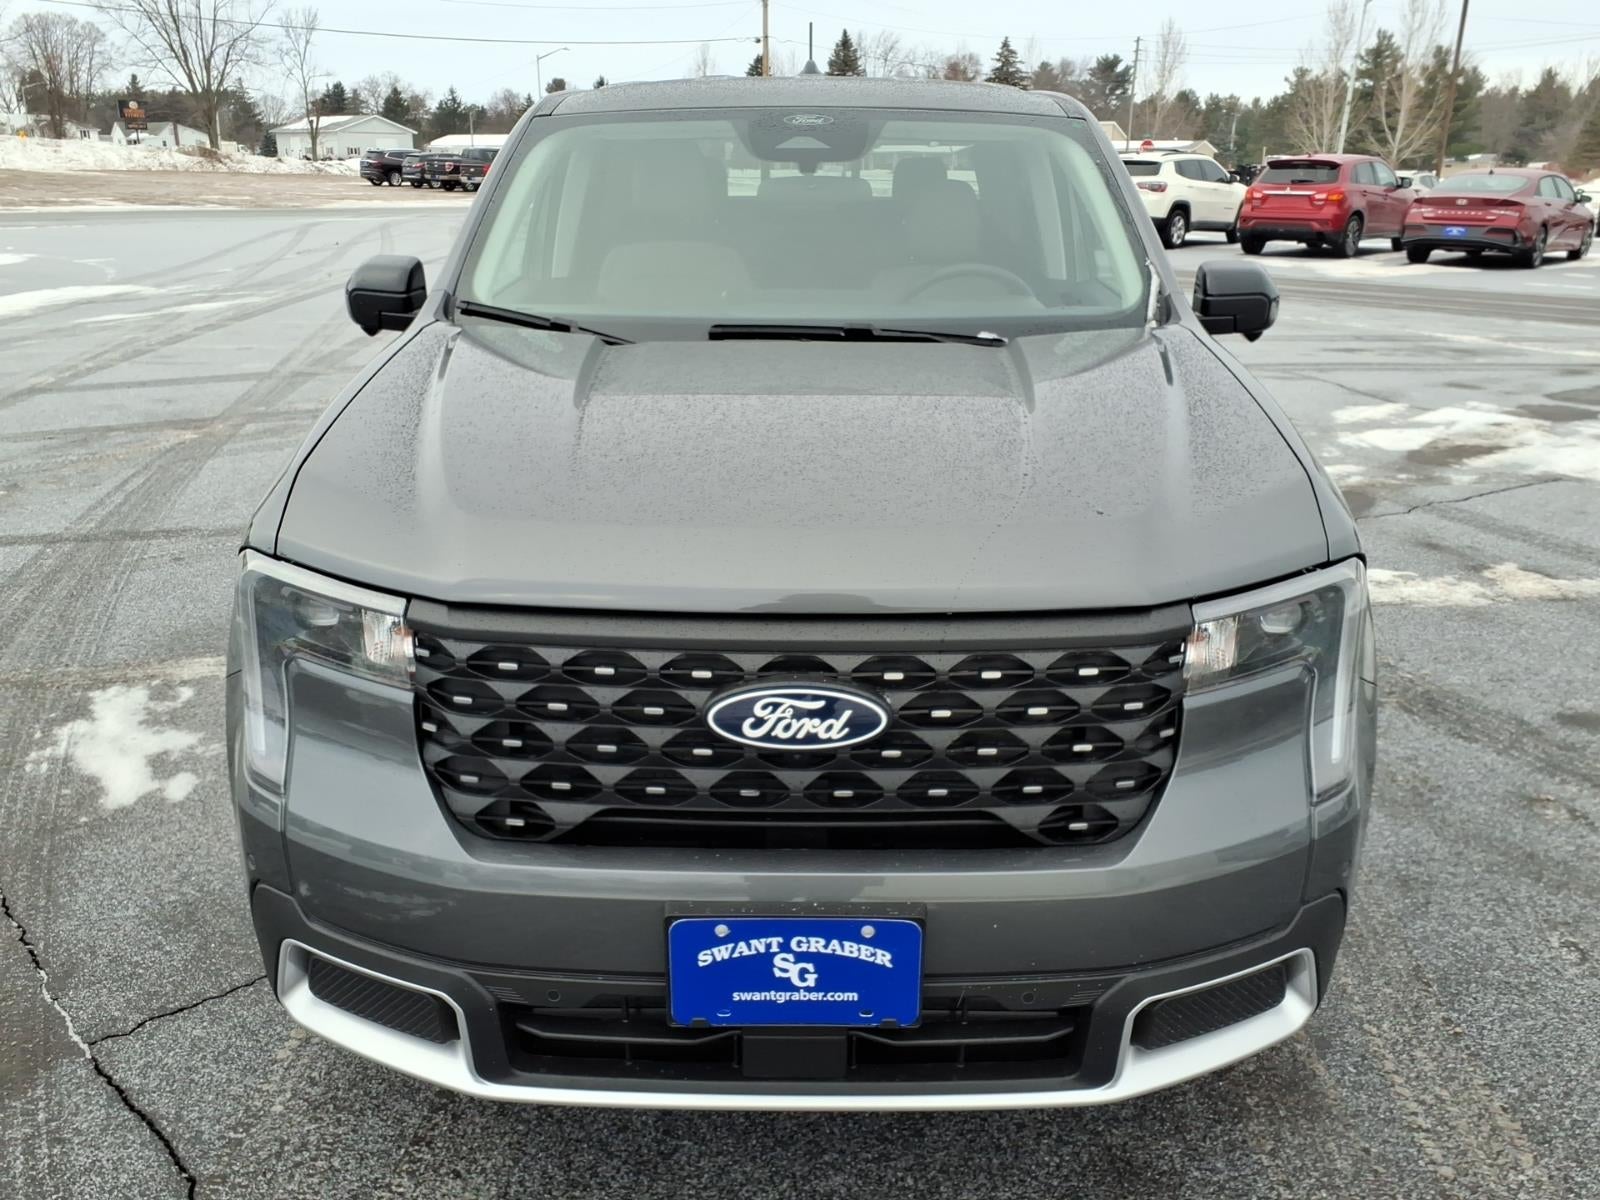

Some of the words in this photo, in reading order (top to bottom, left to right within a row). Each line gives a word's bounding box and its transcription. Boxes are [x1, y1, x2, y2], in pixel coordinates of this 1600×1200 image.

[742, 697, 853, 739] Ford
[697, 937, 783, 968] SWANT
[790, 936, 893, 968] GRABER
[773, 953, 818, 988] SG
[732, 990, 858, 1004] swantgraber.com
